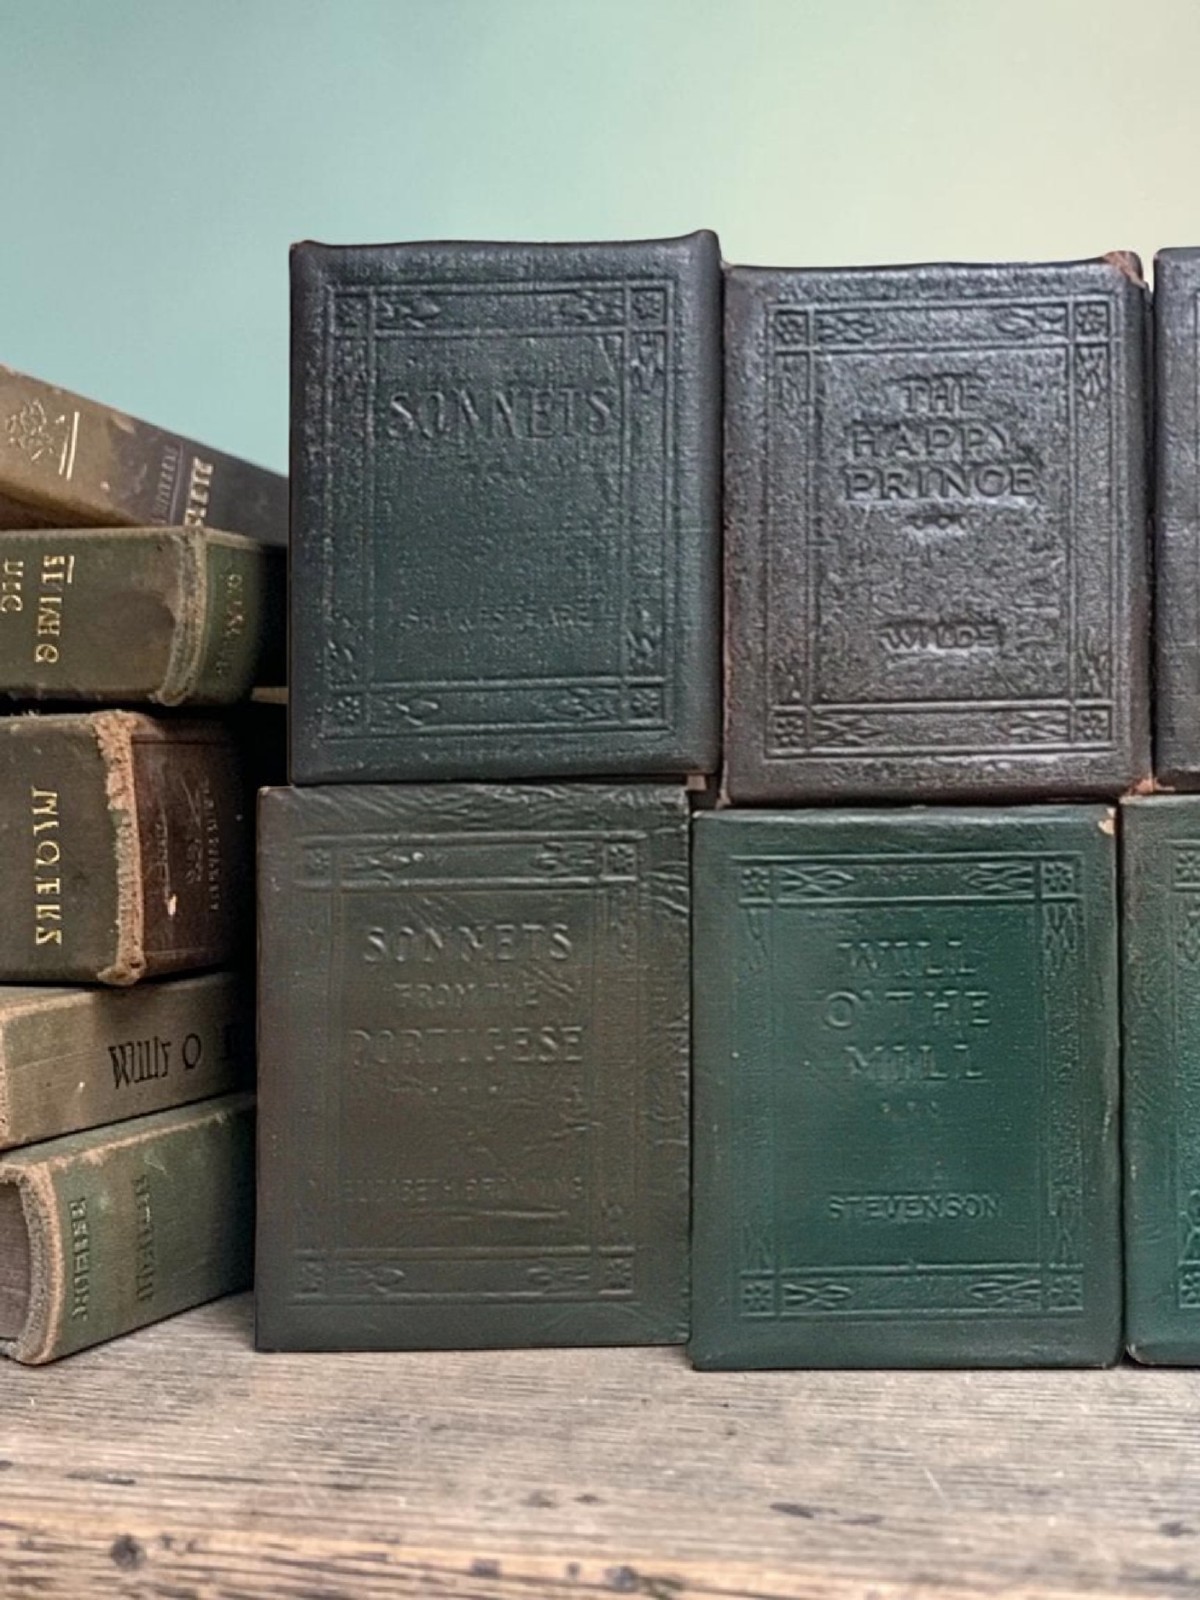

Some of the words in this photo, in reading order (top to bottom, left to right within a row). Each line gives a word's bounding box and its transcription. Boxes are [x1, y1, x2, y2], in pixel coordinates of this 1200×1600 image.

[897, 375, 985, 413] THE
[386, 386, 614, 442] SONNETS
[845, 422, 1022, 458] HAPPY
[842, 462, 1040, 501] PRINCE
[877, 625, 1000, 651] WILDE
[363, 921, 573, 964] SONNETS
[837, 938, 979, 978] WILL
[844, 1041, 985, 1082] MILL
